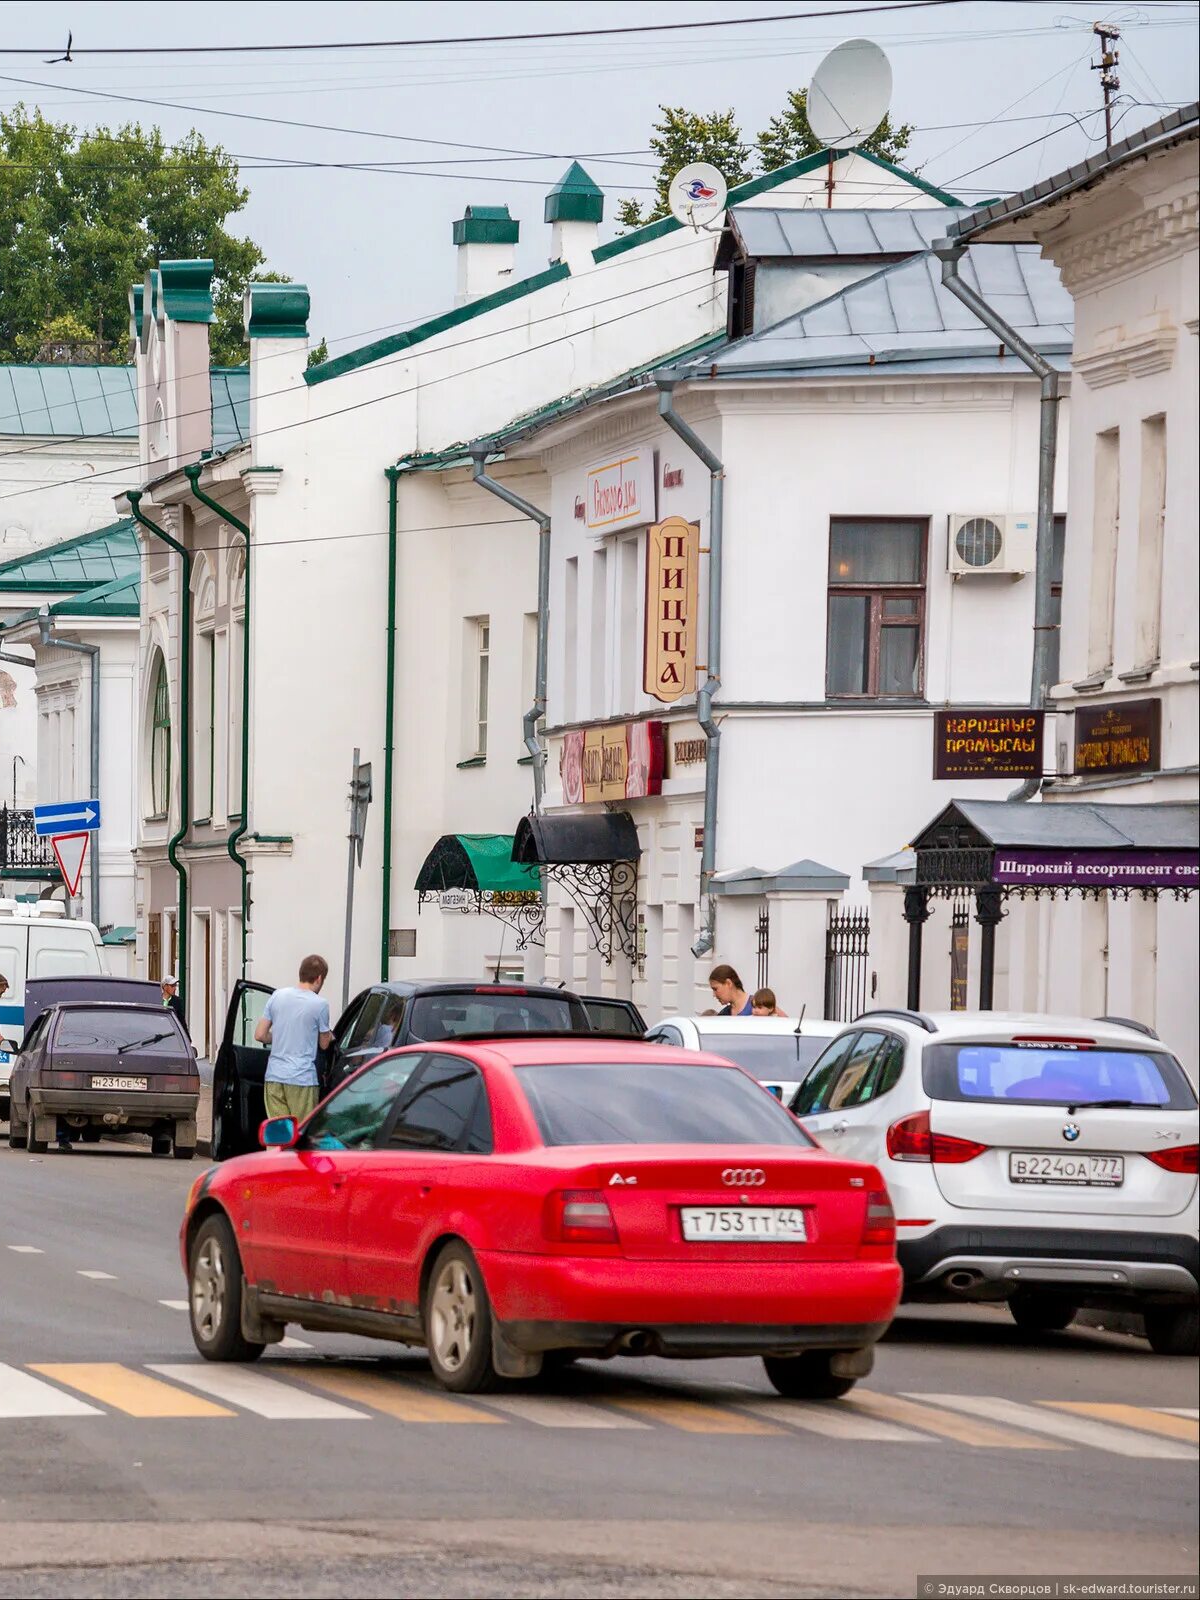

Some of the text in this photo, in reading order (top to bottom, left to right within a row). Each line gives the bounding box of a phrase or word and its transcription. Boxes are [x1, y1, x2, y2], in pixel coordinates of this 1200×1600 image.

[660, 536, 687, 684] ПИЦЦА
[946, 738, 1036, 753] ПРОМЫСЛЫ
[1000, 861, 1073, 876] Широкий
[1076, 864, 1172, 877] ассортимент
[95, 1077, 132, 1088] Н231ОЕ
[1017, 1158, 1118, 1177] В224ОА 777
[692, 1211, 796, 1232] Т753ТТ 44
